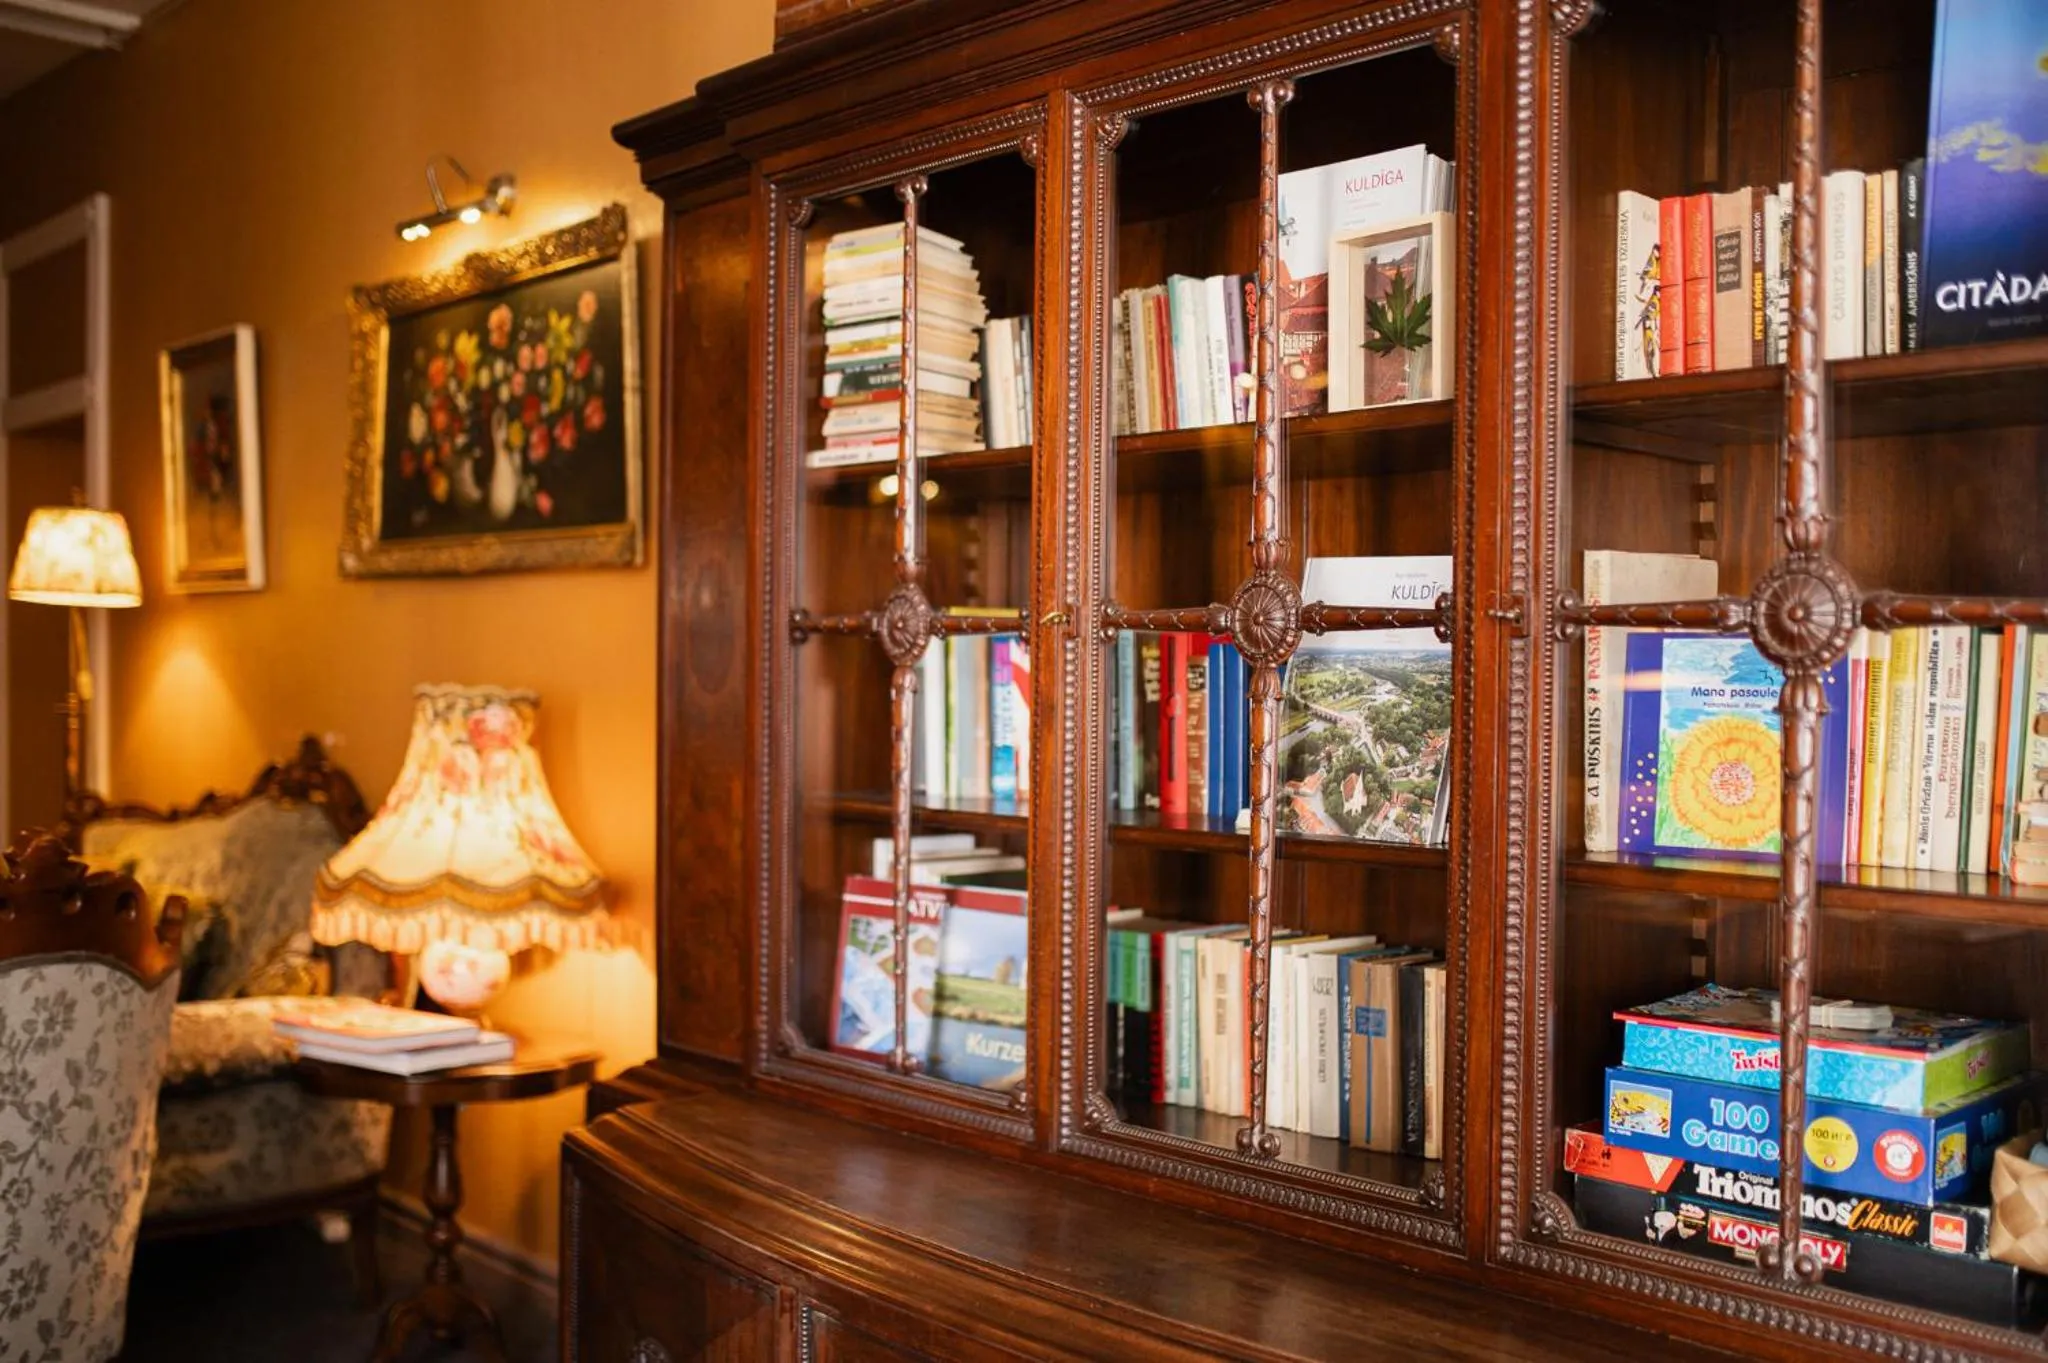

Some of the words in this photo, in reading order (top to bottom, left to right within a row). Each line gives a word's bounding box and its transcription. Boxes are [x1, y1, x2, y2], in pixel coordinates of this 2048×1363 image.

[1345, 169, 1404, 195] KULDĪGA
[1391, 581, 1444, 600] KULDĪ
[1587, 597, 1602, 681] PASAS
[1691, 686, 1726, 698] Mana
[1730, 686, 1778, 700] pasaule
[1732, 1049, 1780, 1071] Twist
[1710, 1097, 1769, 1134] 100
[1682, 1119, 1780, 1161] Game
[1811, 1127, 1829, 1140] 100
[1738, 1171, 1774, 1186] Original
[1693, 1163, 1852, 1226] Triomnos
[1848, 1199, 1920, 1237] Classic
[1713, 1221, 1843, 1265] MONOOLY
